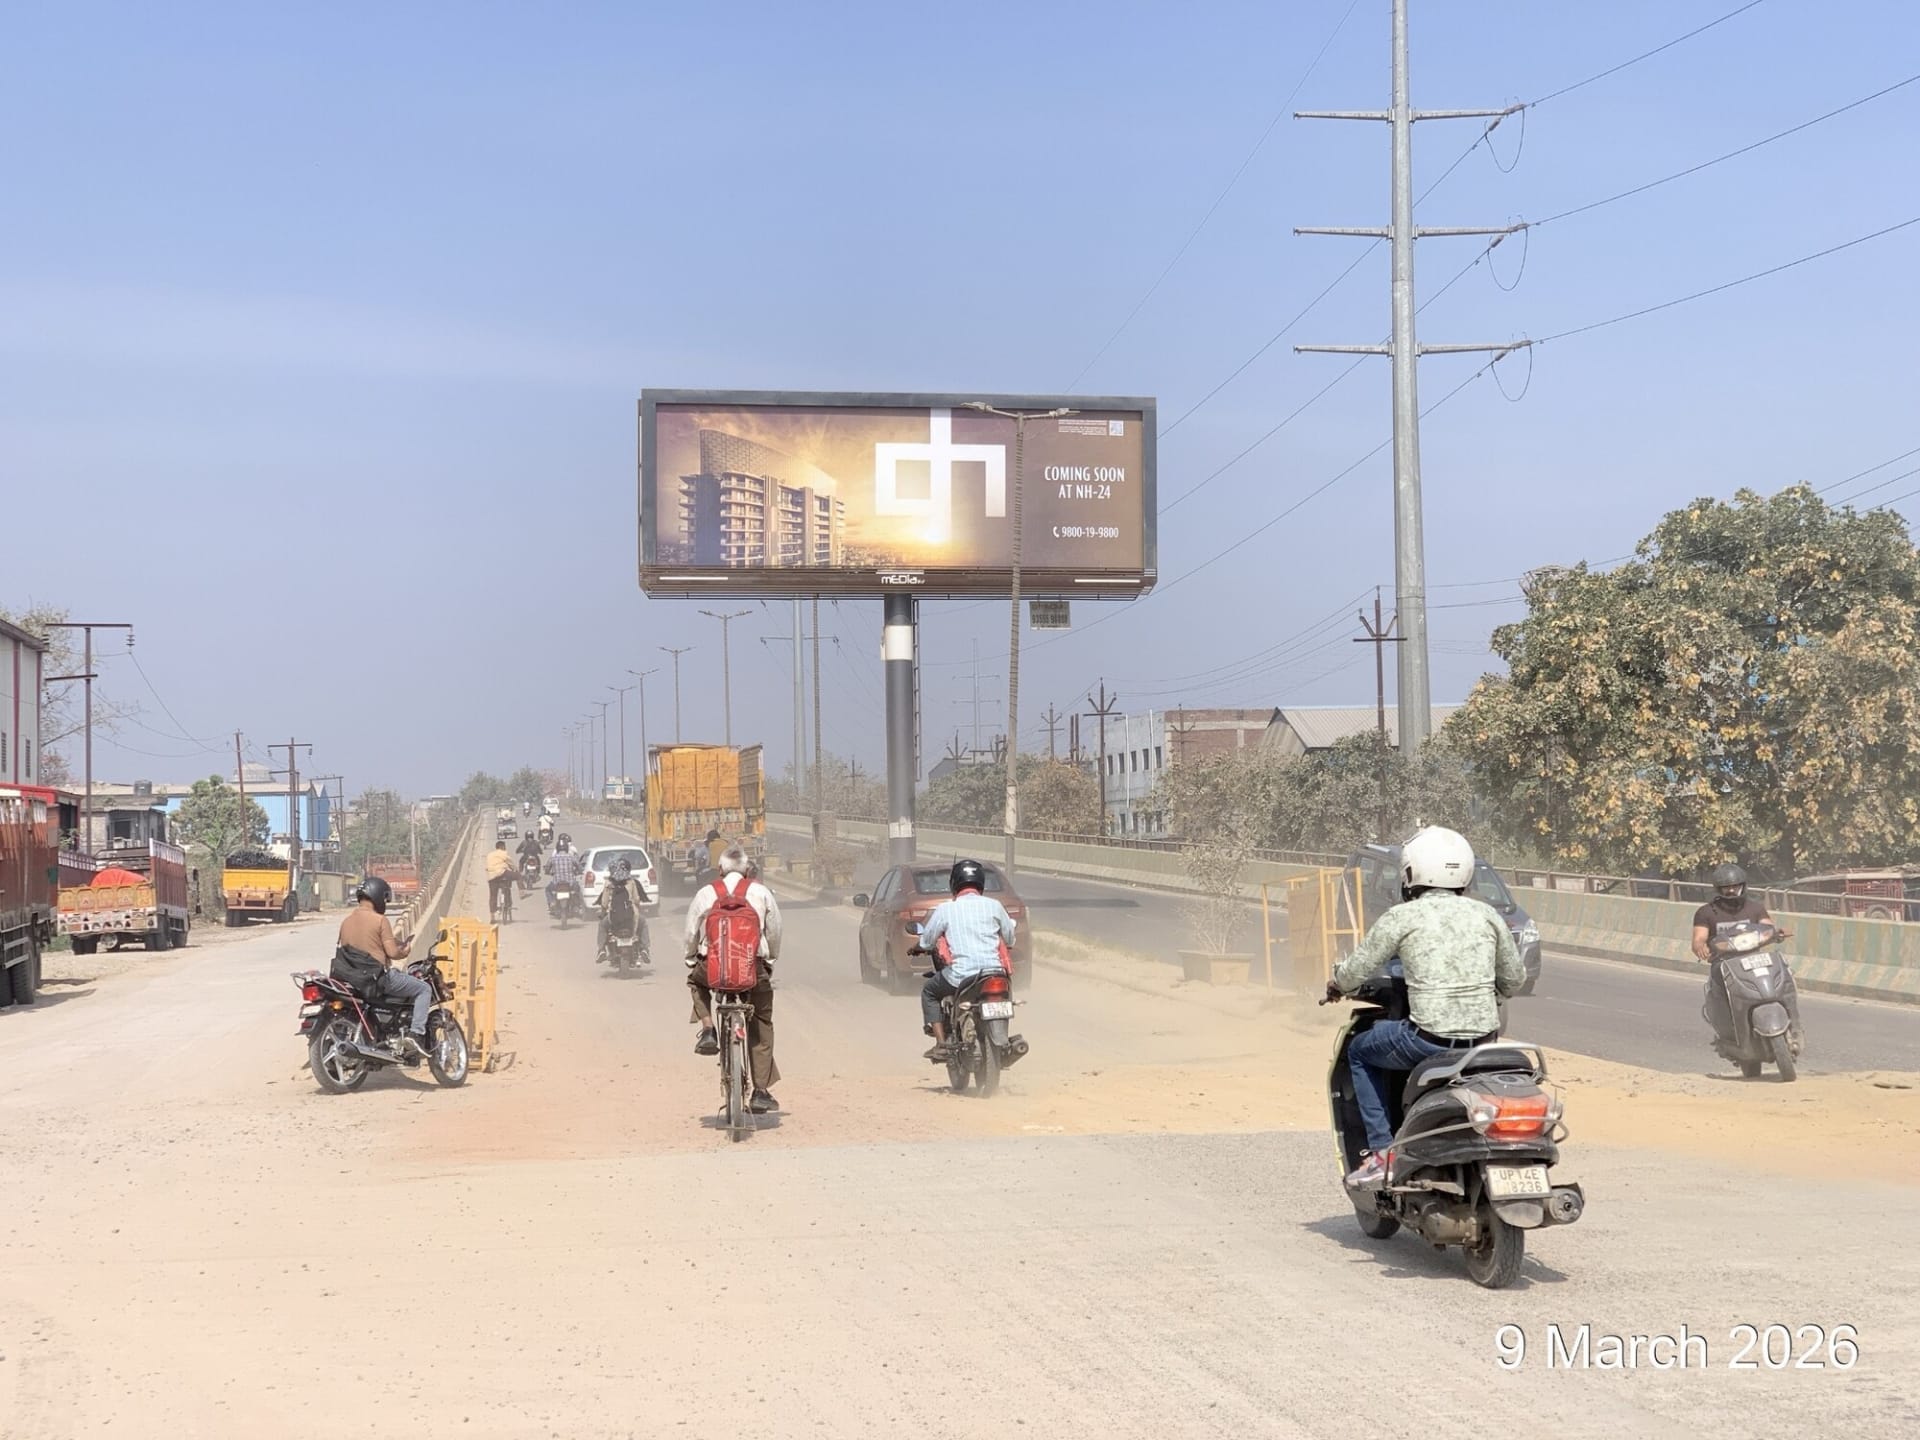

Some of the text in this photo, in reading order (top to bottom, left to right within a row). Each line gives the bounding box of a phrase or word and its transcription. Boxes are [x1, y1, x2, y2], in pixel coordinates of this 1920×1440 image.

[1044, 466, 1125, 482] COMING SOON
[1058, 484, 1111, 499] AT NH-24
[1061, 526, 1119, 538] 9800-19-9800
